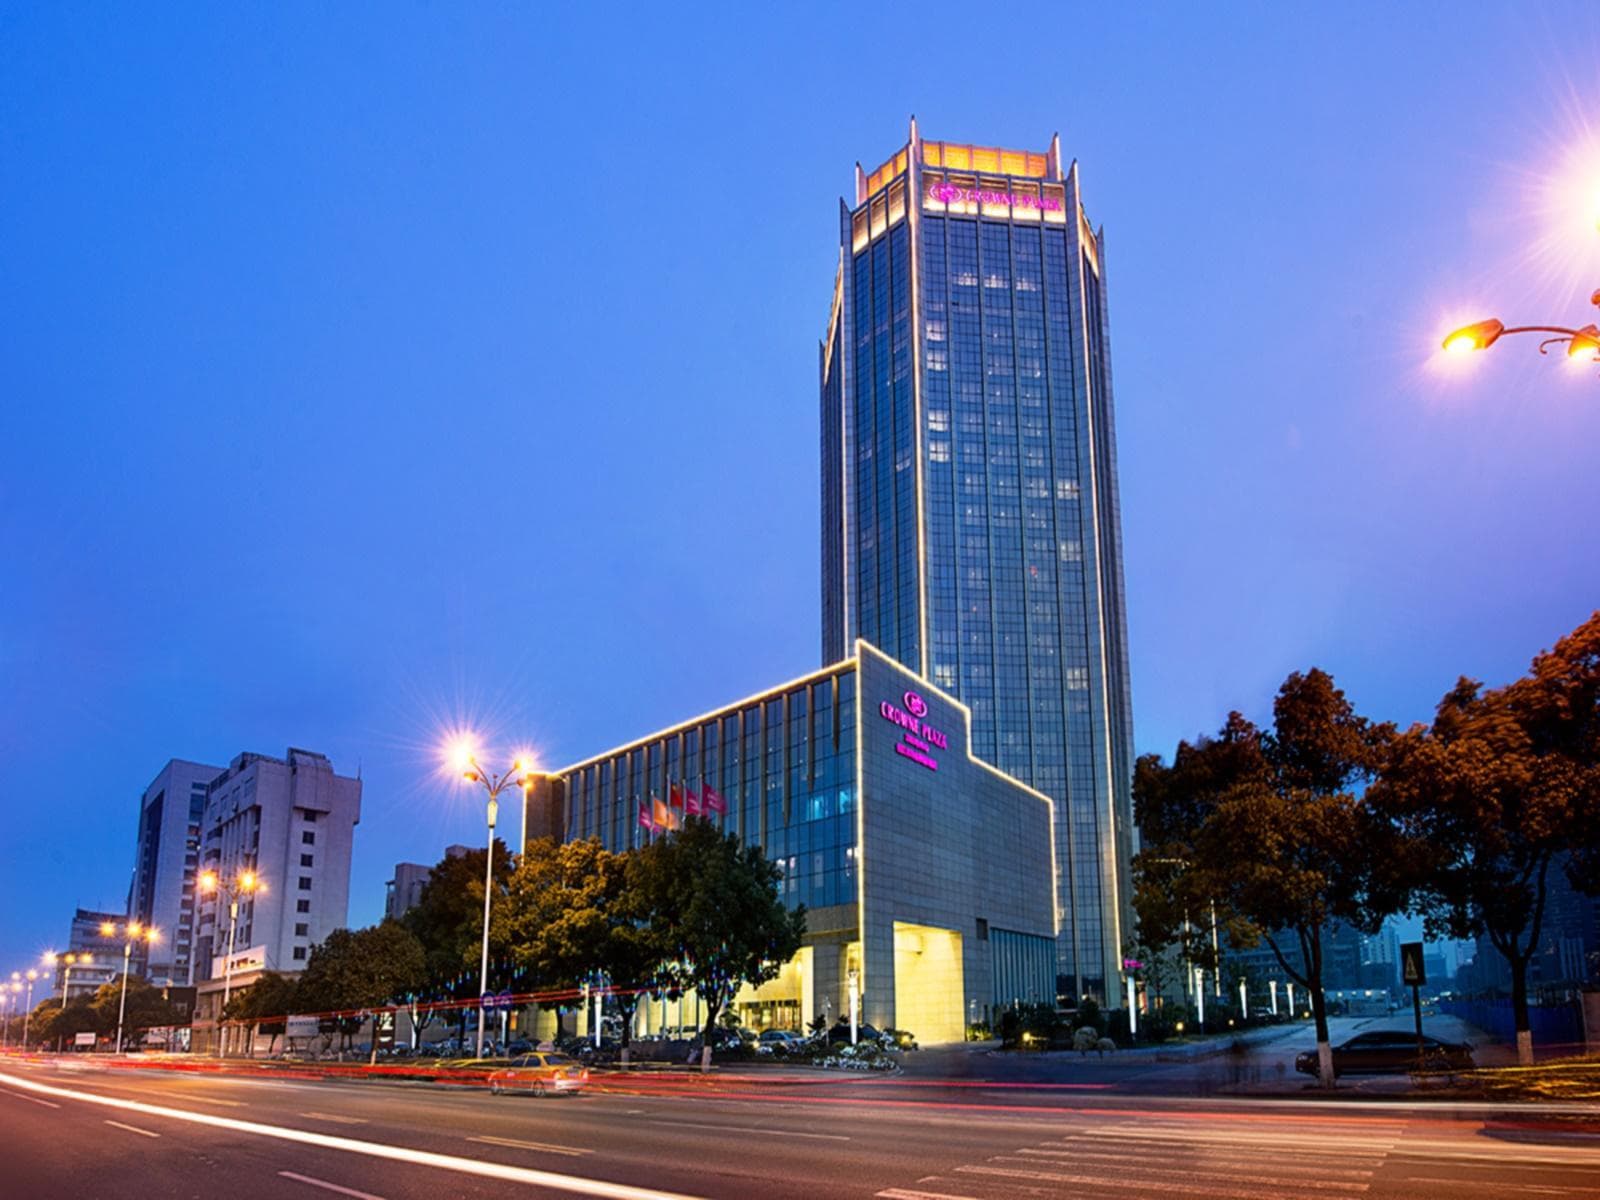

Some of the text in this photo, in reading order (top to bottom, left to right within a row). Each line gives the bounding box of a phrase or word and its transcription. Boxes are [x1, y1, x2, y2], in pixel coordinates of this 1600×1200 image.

[966, 189, 1018, 208] CROWNE
[880, 701, 919, 735] CROWNE
[922, 723, 948, 751] PLAZA
